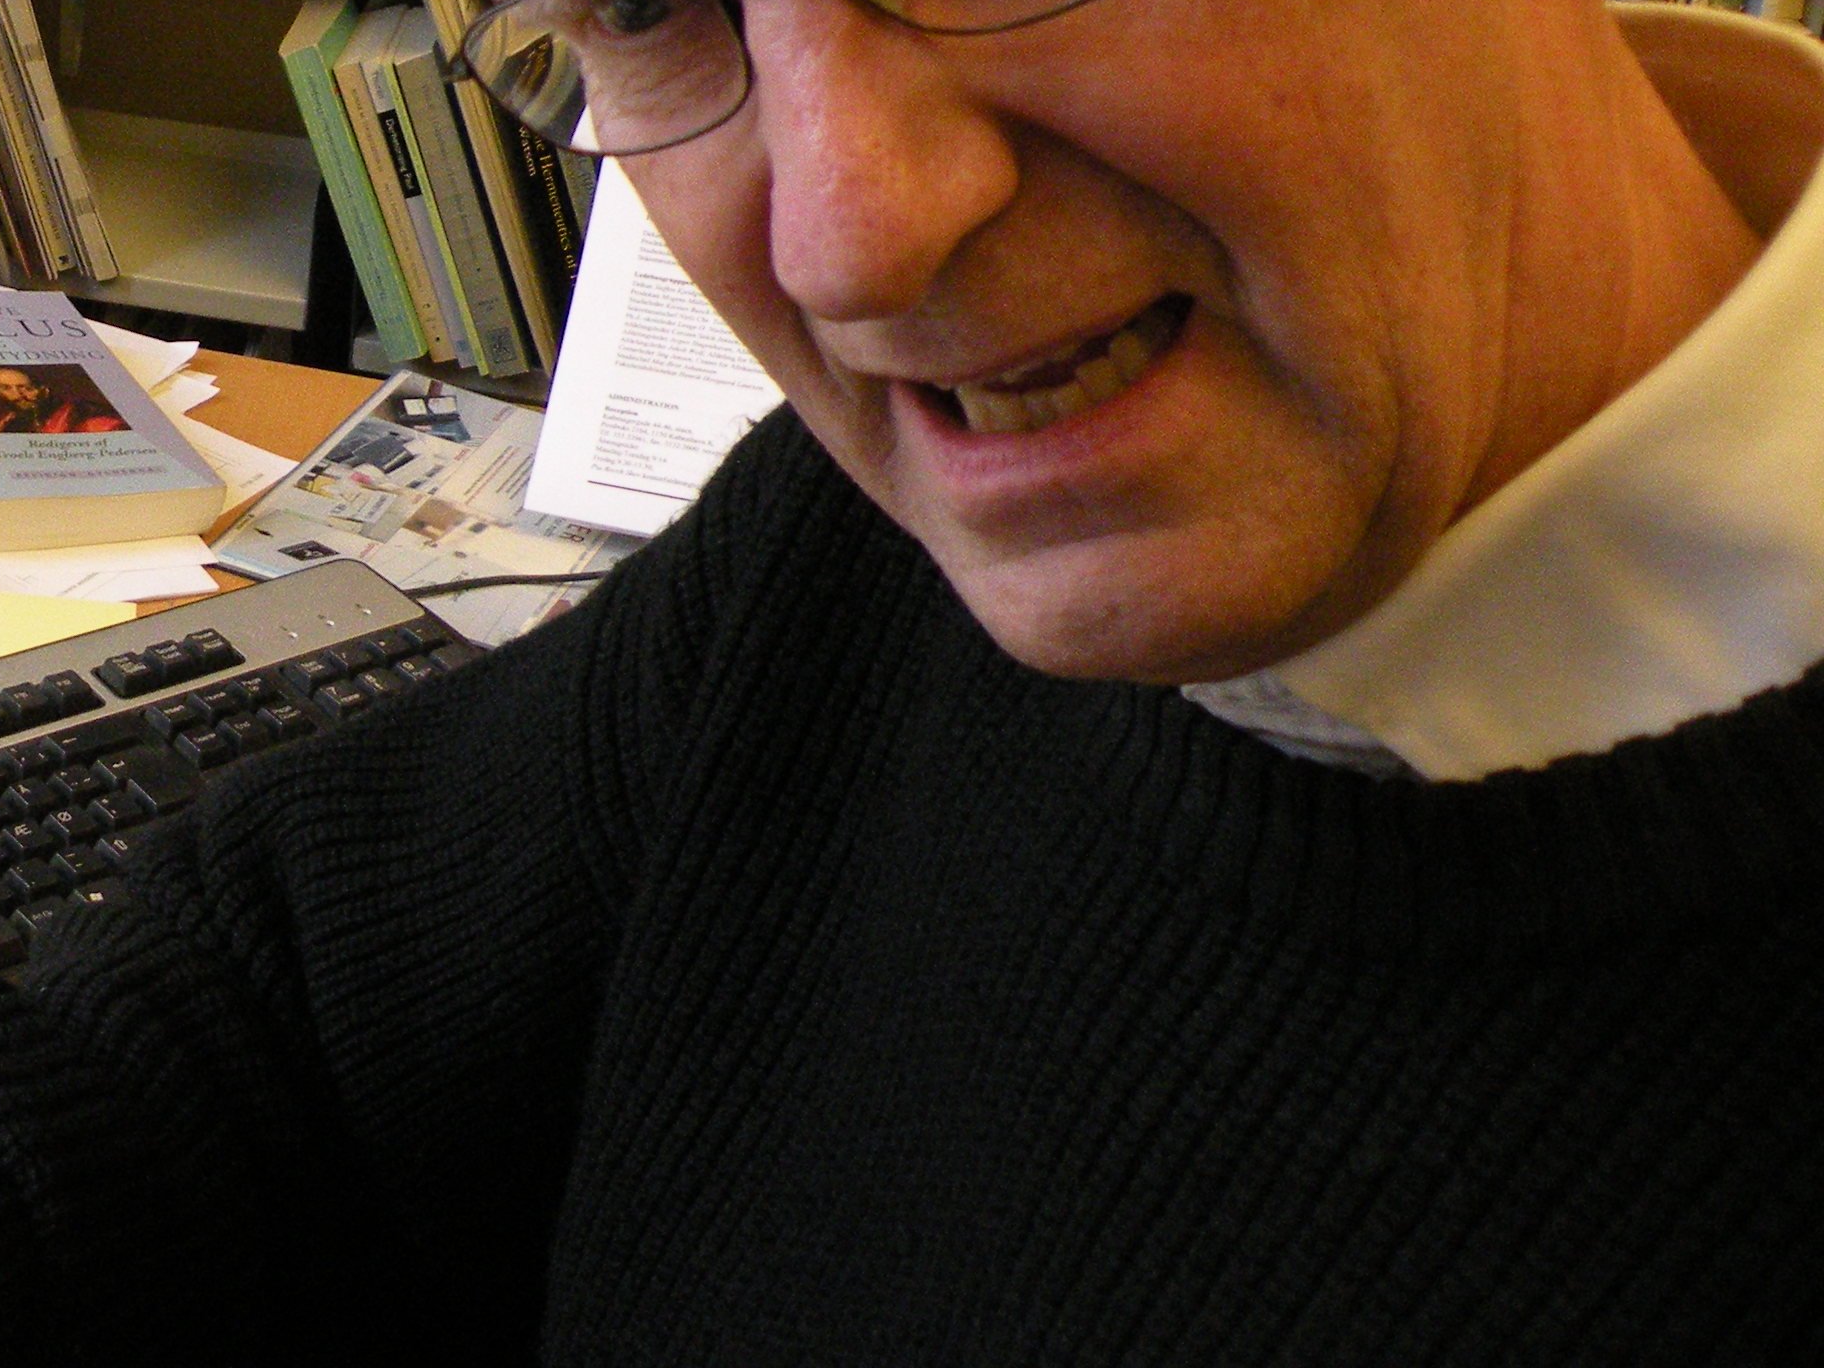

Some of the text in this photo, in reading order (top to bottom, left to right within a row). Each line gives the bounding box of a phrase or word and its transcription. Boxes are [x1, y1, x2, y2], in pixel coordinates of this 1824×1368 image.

[514, 124, 541, 176] Watson
[403, 172, 415, 190] Paul
[538, 154, 577, 269] Hermeneutics of
[28, 438, 109, 450] Redigeret af
